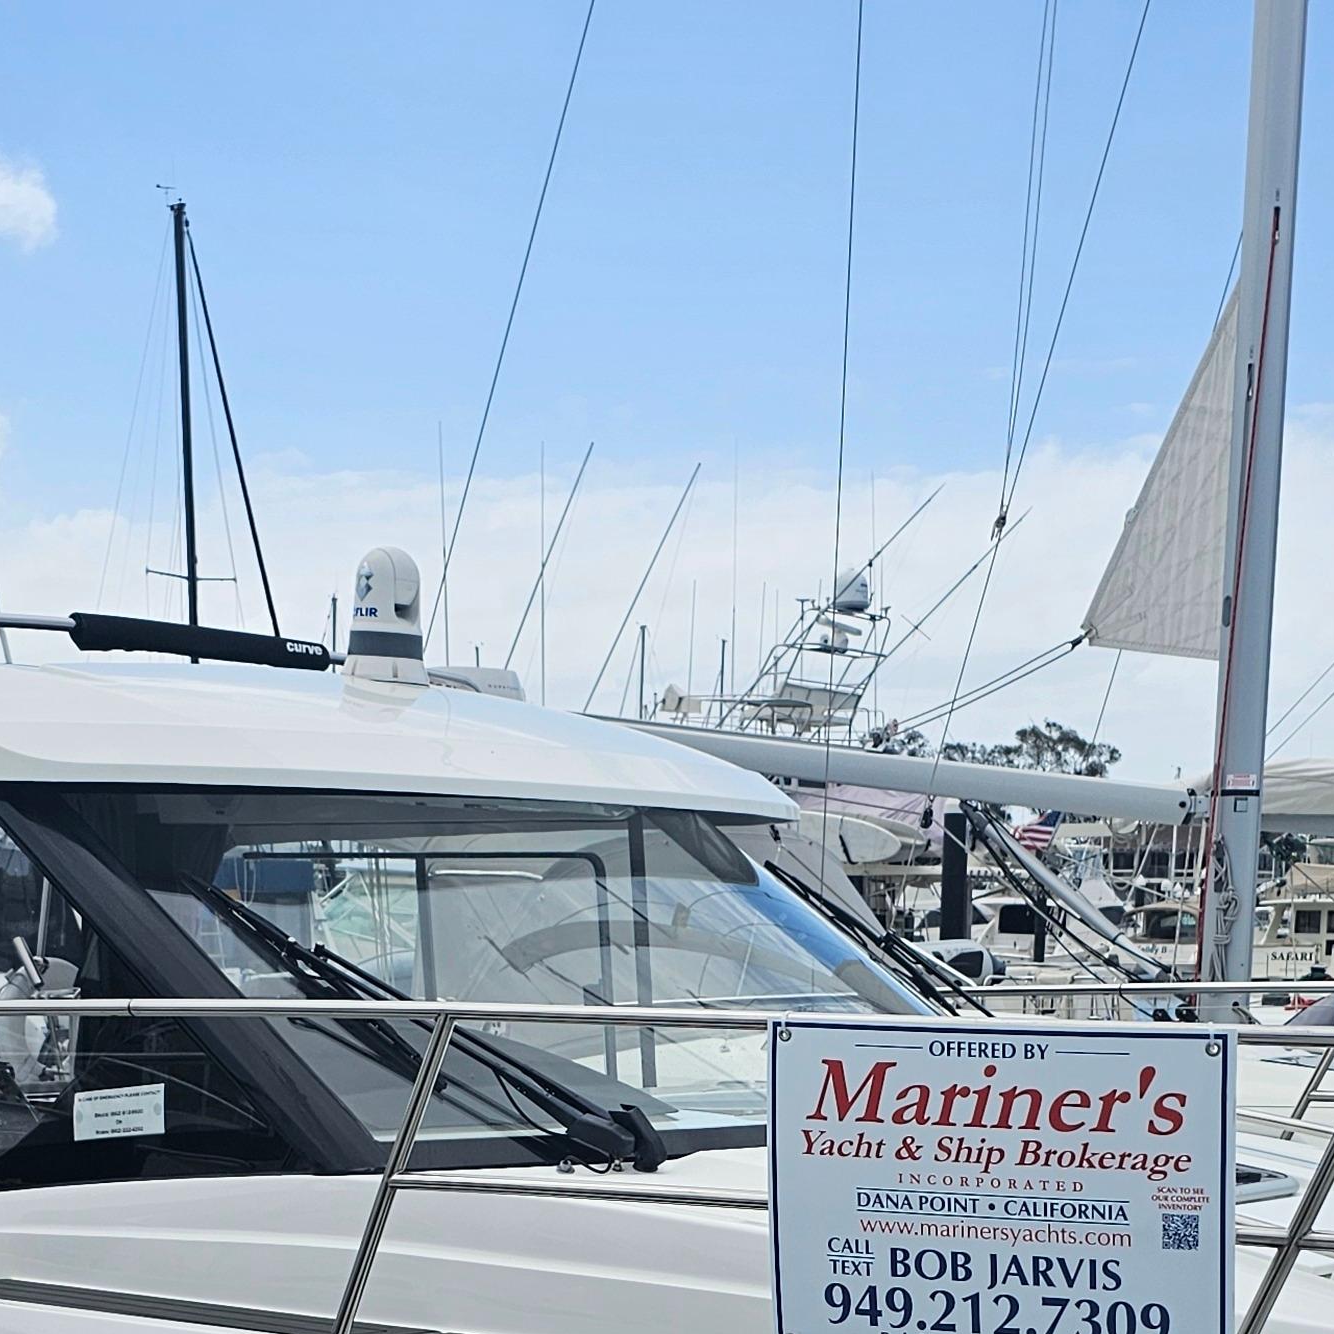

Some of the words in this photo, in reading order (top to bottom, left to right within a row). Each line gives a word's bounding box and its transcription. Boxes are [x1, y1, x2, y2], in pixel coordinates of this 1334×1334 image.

[286, 642, 323, 655] curve
[1271, 951, 1314, 961] SAFARI
[928, 1040, 1017, 1058] OFFERED
[1024, 1043, 1049, 1060] BY
[805, 1058, 1188, 1136] Mariner's
[801, 1129, 887, 1159] Yacht
[894, 1136, 924, 1161] &
[933, 1136, 1006, 1174] Ship
[1014, 1139, 1192, 1182] Brokerage
[898, 1173, 1084, 1192] INCORPORATED
[1157, 1186, 1178, 1194] SCAN
[1179, 1187, 1191, 1195] TO
[856, 1192, 913, 1210] DANA
[918, 1195, 980, 1214] POINT
[1003, 1200, 1129, 1221] CALIFORNIA
[1158, 1203, 1203, 1211] INVENTORY
[1170, 1195, 1210, 1203] COMPLETE
[860, 1219, 1132, 1247] www.marinersyachts.com
[827, 1236, 874, 1255] CALL
[828, 1258, 874, 1276] TEXT
[889, 1247, 973, 1282] BOB
[987, 1253, 1122, 1291] JARVIS
